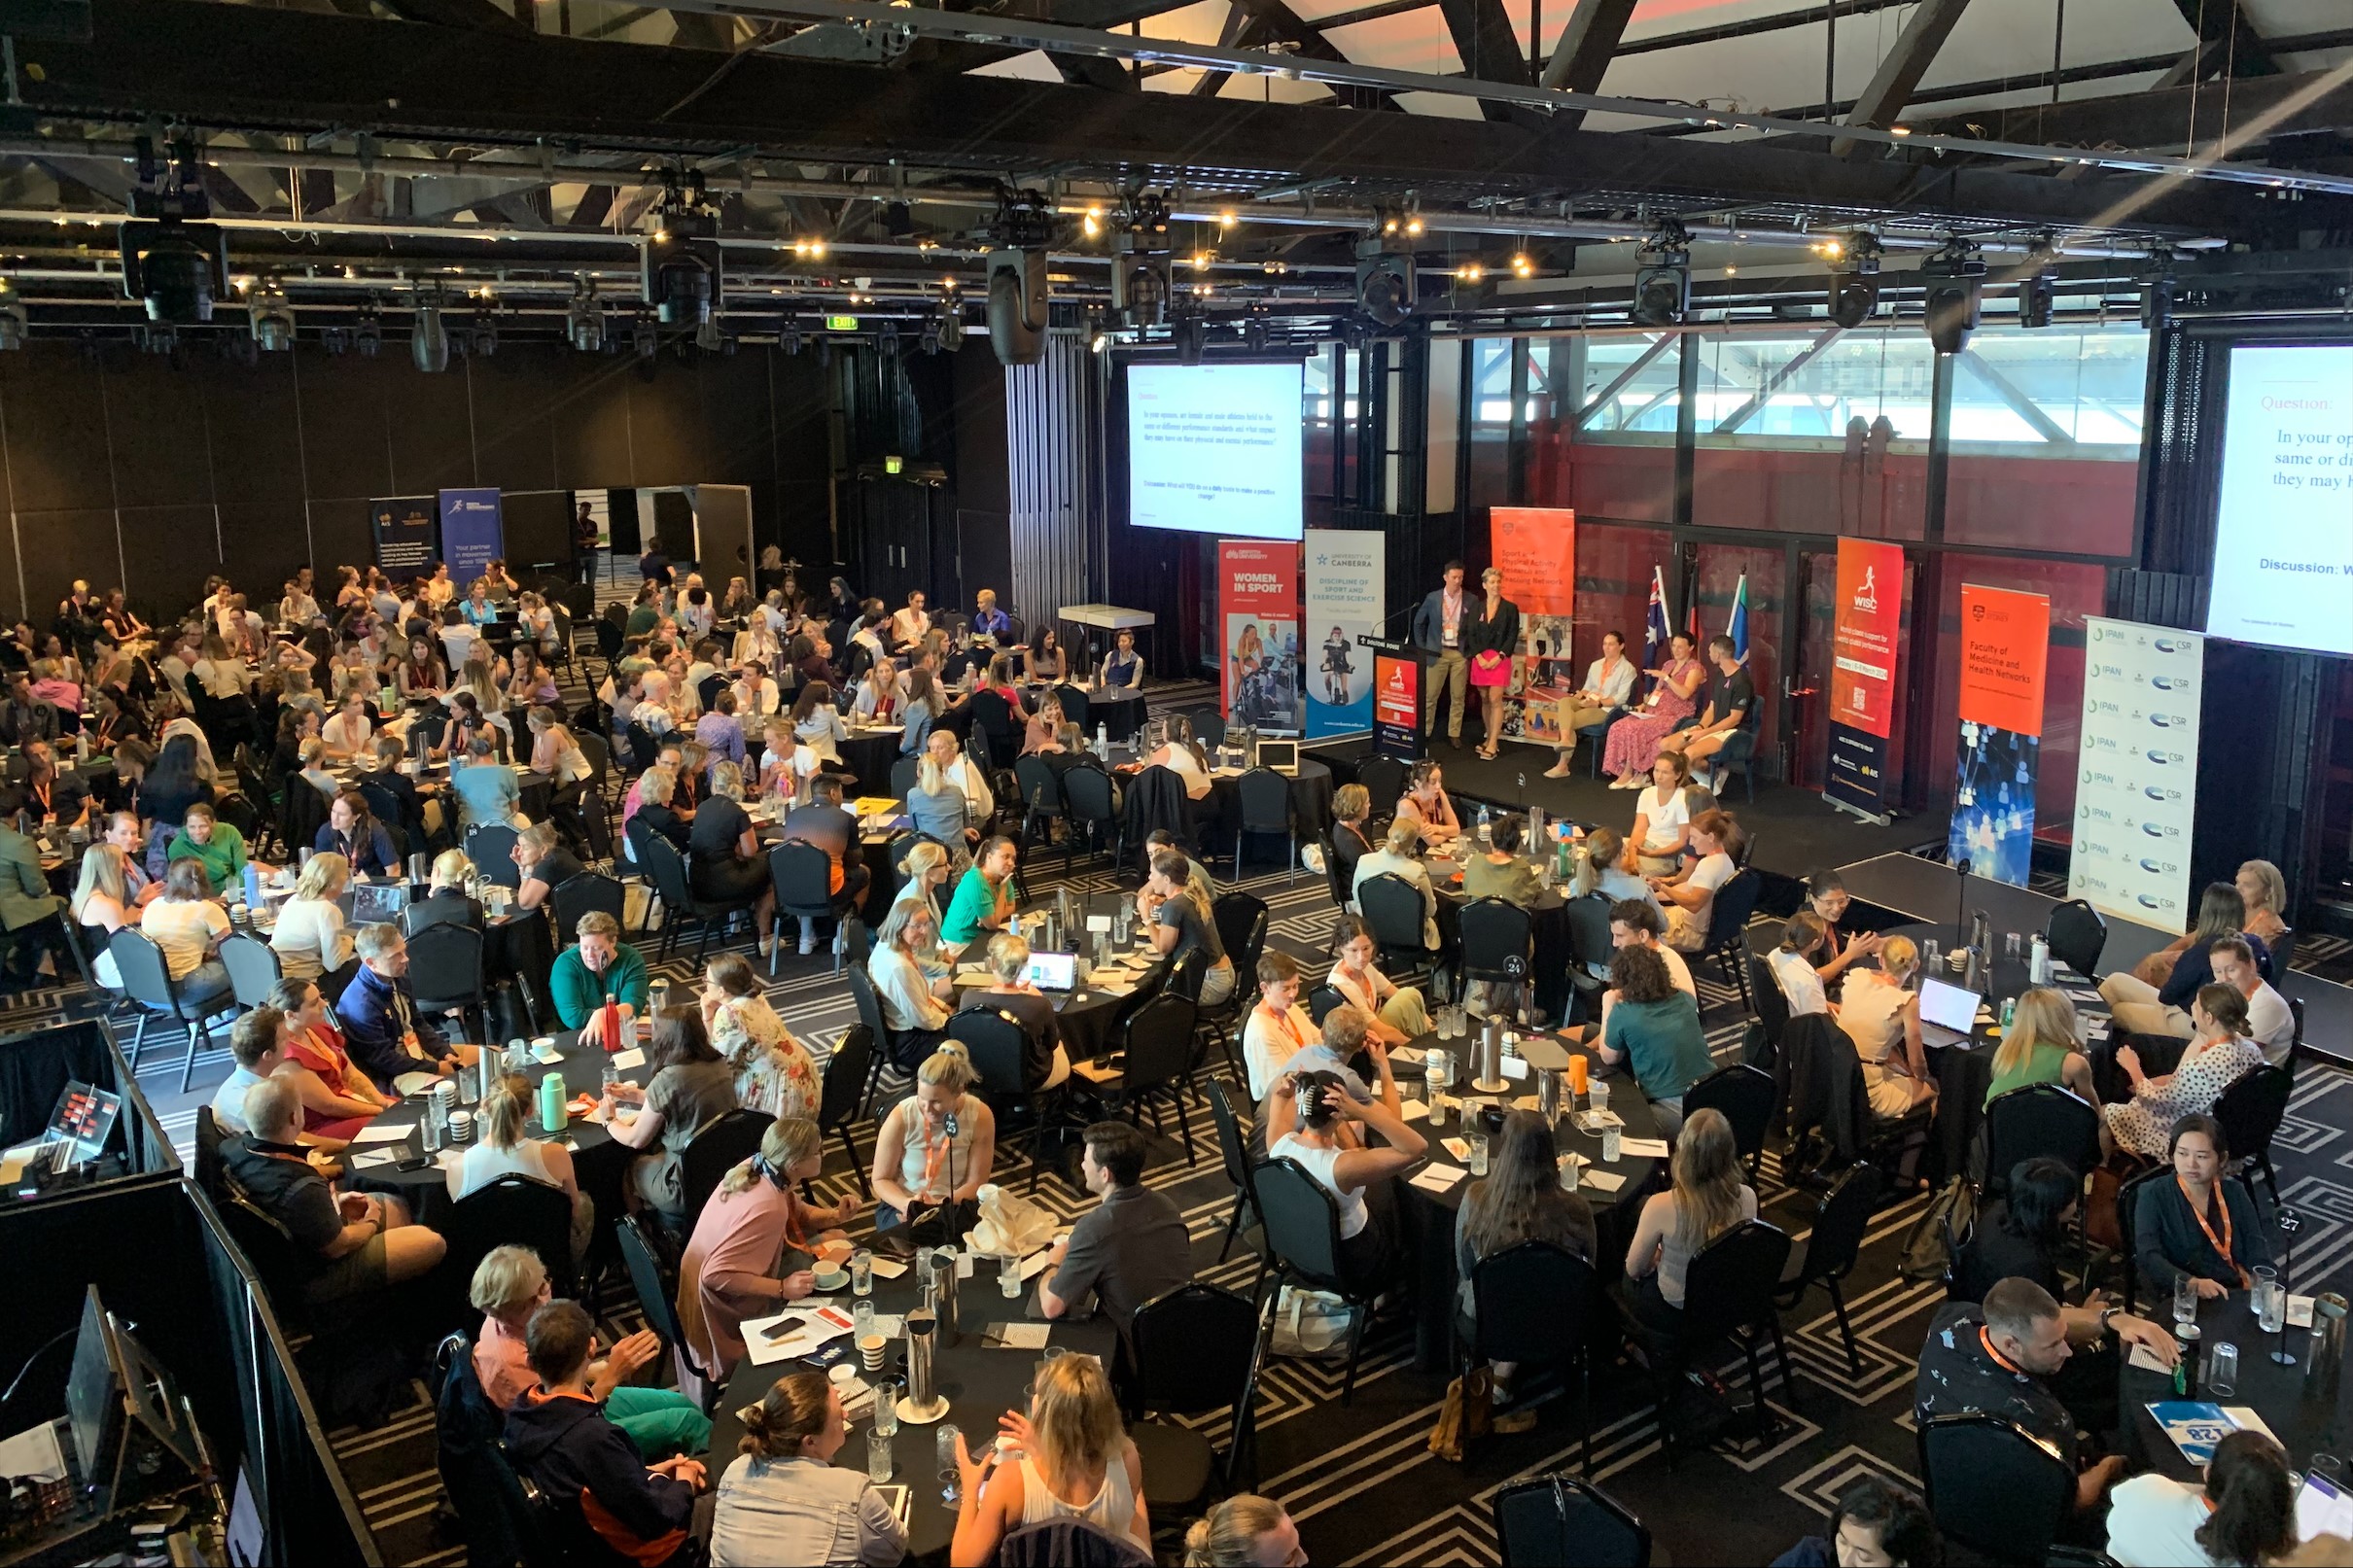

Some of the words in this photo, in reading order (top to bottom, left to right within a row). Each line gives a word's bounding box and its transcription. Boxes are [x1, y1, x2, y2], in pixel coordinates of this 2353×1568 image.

[834, 317, 851, 327] EXIT
[2262, 397, 2333, 410] Question:
[2278, 430, 2291, 443] In
[2297, 434, 2332, 447] your
[2275, 455, 2312, 465] same
[2318, 455, 2334, 466] or
[2273, 472, 2304, 488] they
[2310, 477, 2341, 490] may
[2260, 558, 2339, 575] Discussion:
[1234, 573, 1277, 582] WOMEN
[1503, 576, 1530, 585] eaching
[1234, 583, 1245, 592] IN
[1247, 583, 1283, 593] SPORT
[1854, 596, 1878, 610] WISC
[2105, 630, 2124, 639] IPAN
[1970, 642, 1997, 654] Faculty
[2177, 641, 2192, 651] CSR
[1969, 652, 2004, 666] Medicine
[1968, 664, 1993, 676] Health
[1996, 669, 2030, 683] Networks
[2103, 667, 2121, 677] IPAN
[2174, 679, 2189, 688] CSR
[2099, 702, 2118, 712] IPAN
[2171, 715, 2186, 725] CSR
[2097, 737, 2116, 748] IPAN
[2169, 752, 2184, 763] CSR
[2094, 773, 2113, 784] IPAN
[2166, 789, 2181, 800] CSR
[2092, 809, 2111, 819] IPAN
[2164, 826, 2179, 837] CSR
[2090, 843, 2108, 854] IPAN
[2162, 862, 2177, 873] CSR
[2088, 878, 2106, 889] IPAN
[2160, 898, 2175, 909] CSR
[1508, 962, 1520, 974] 24
[945, 1121, 957, 1133] 25
[2280, 1217, 2299, 1231] 27
